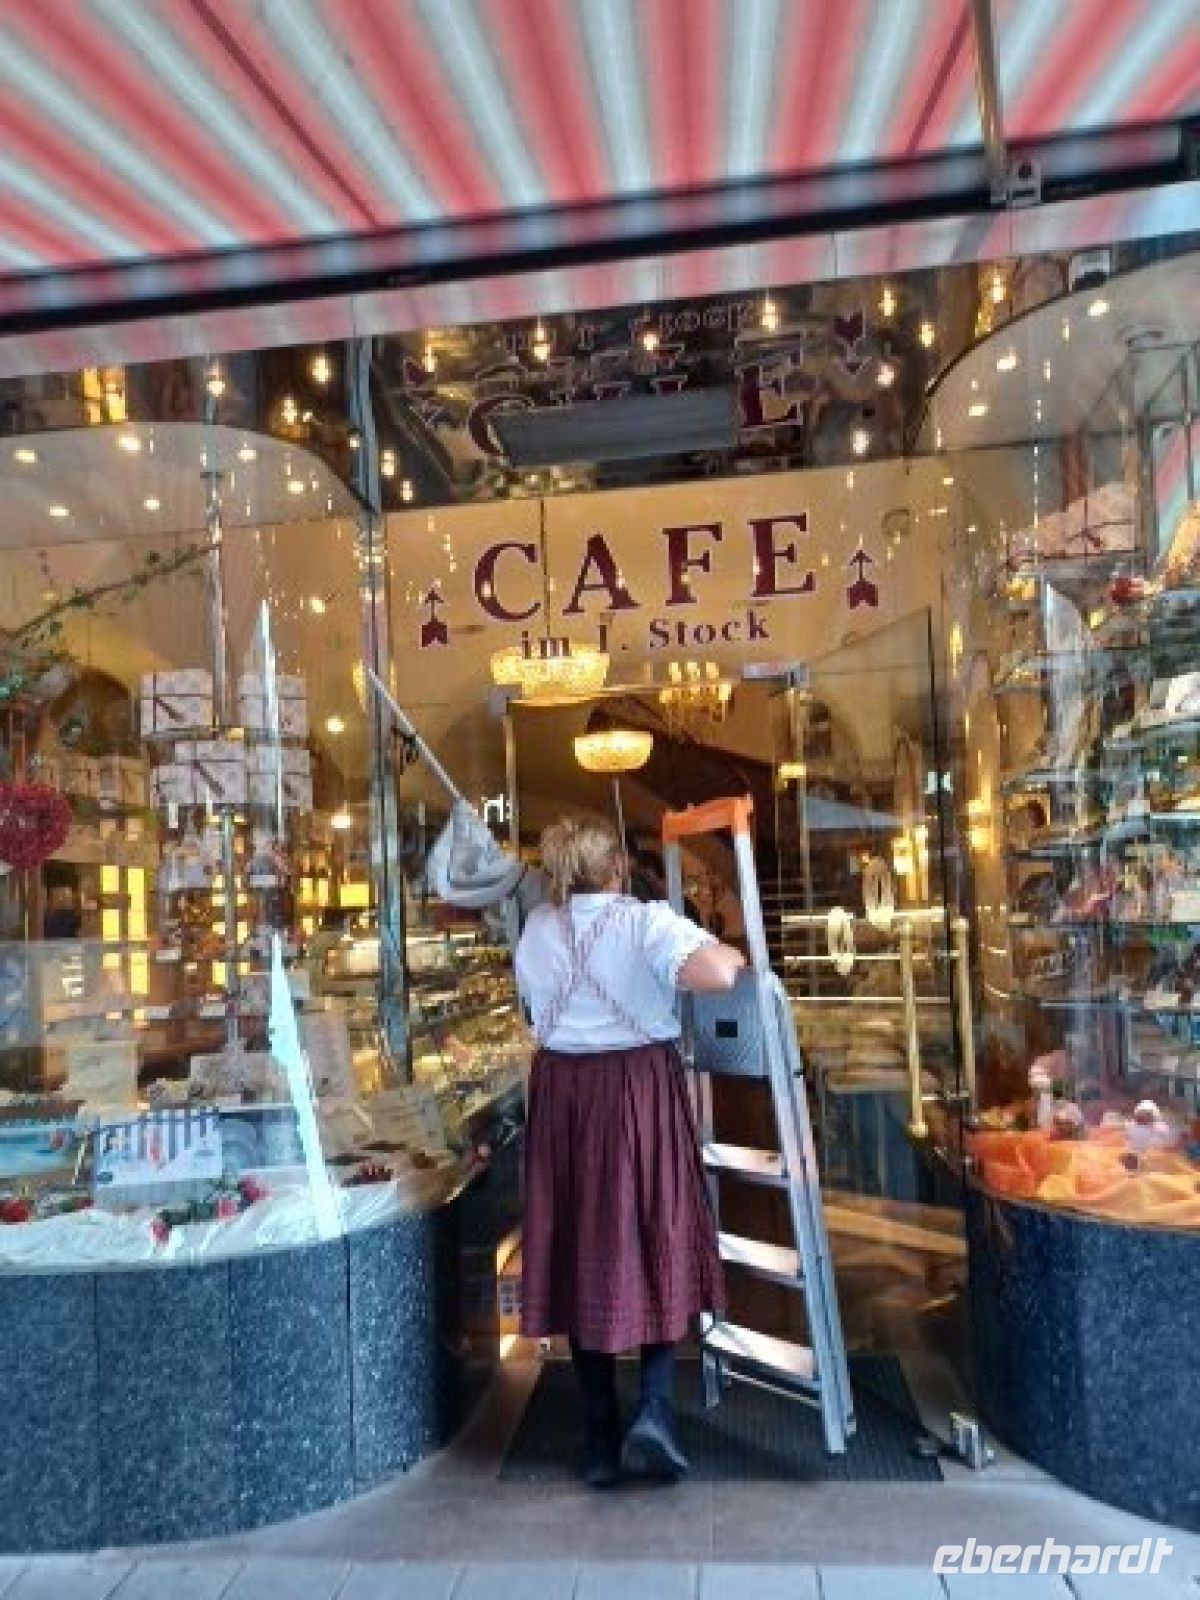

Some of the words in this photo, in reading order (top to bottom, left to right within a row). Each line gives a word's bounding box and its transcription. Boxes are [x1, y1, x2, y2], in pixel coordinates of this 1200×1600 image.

[474, 512, 815, 621] CAFE
[521, 630, 570, 659] im
[649, 609, 769, 648] Stock
